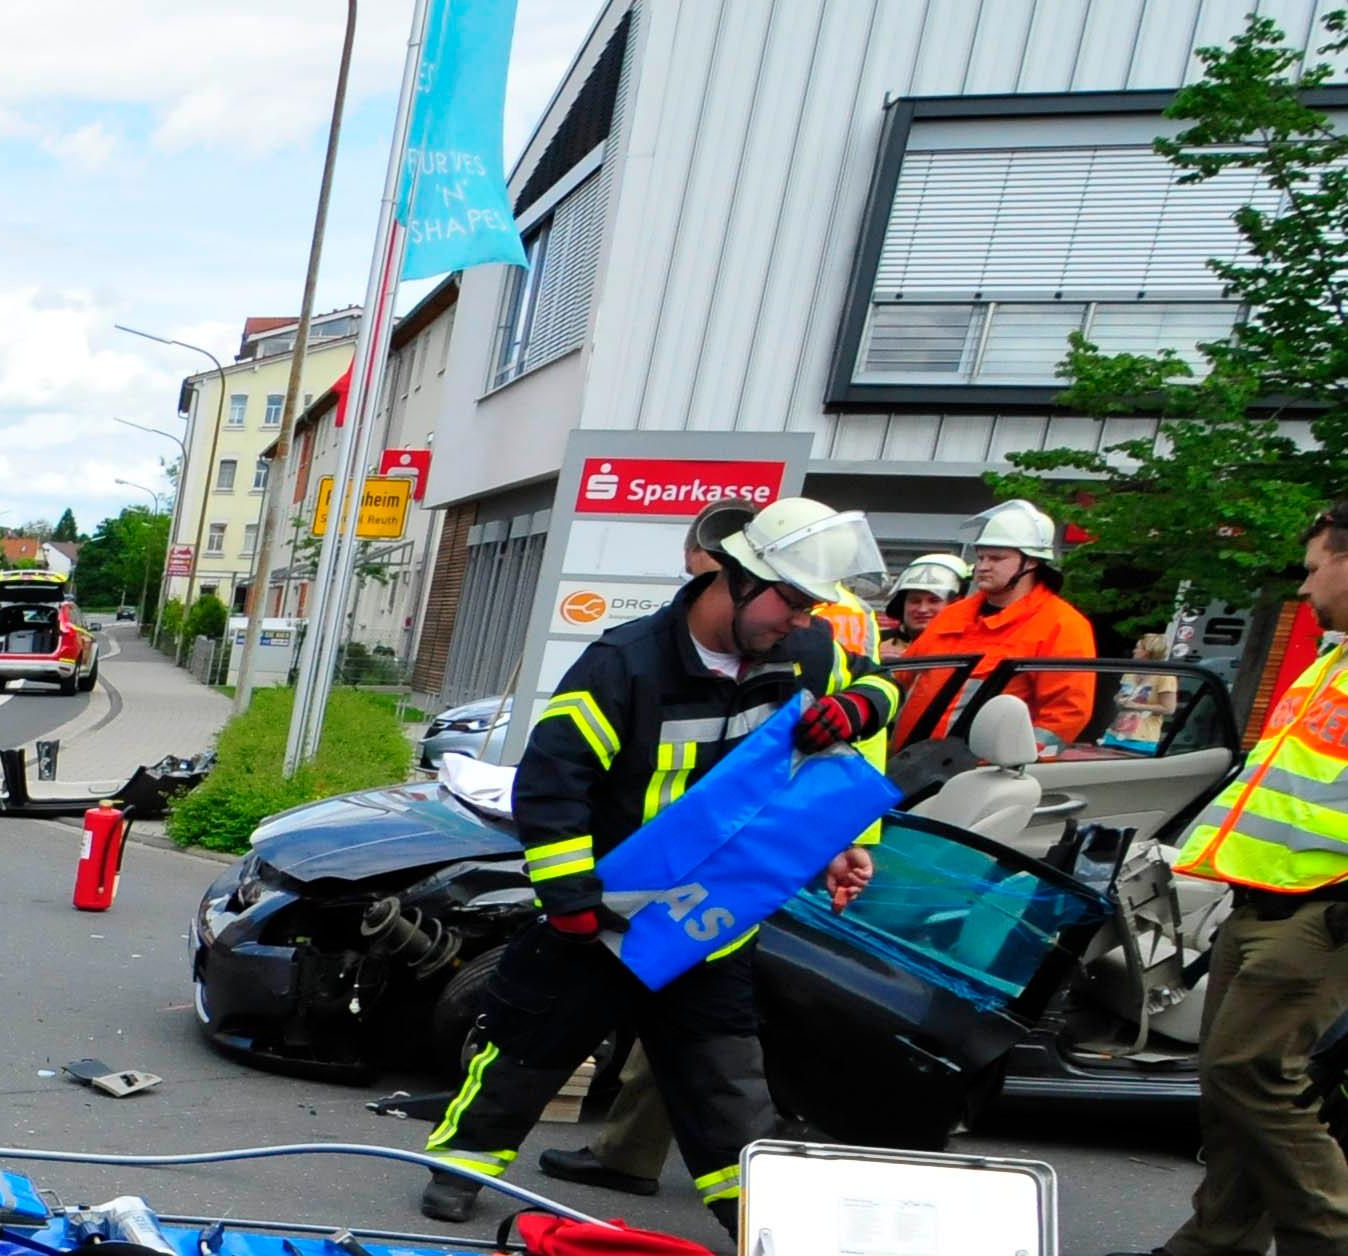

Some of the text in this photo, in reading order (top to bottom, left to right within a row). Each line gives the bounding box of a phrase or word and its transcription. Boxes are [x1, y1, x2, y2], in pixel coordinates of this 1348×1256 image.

[410, 206, 508, 244] SHAPES
[325, 489, 401, 509] Fheim
[627, 479, 770, 506] Sparkasse
[367, 514, 398, 525] Reuth
